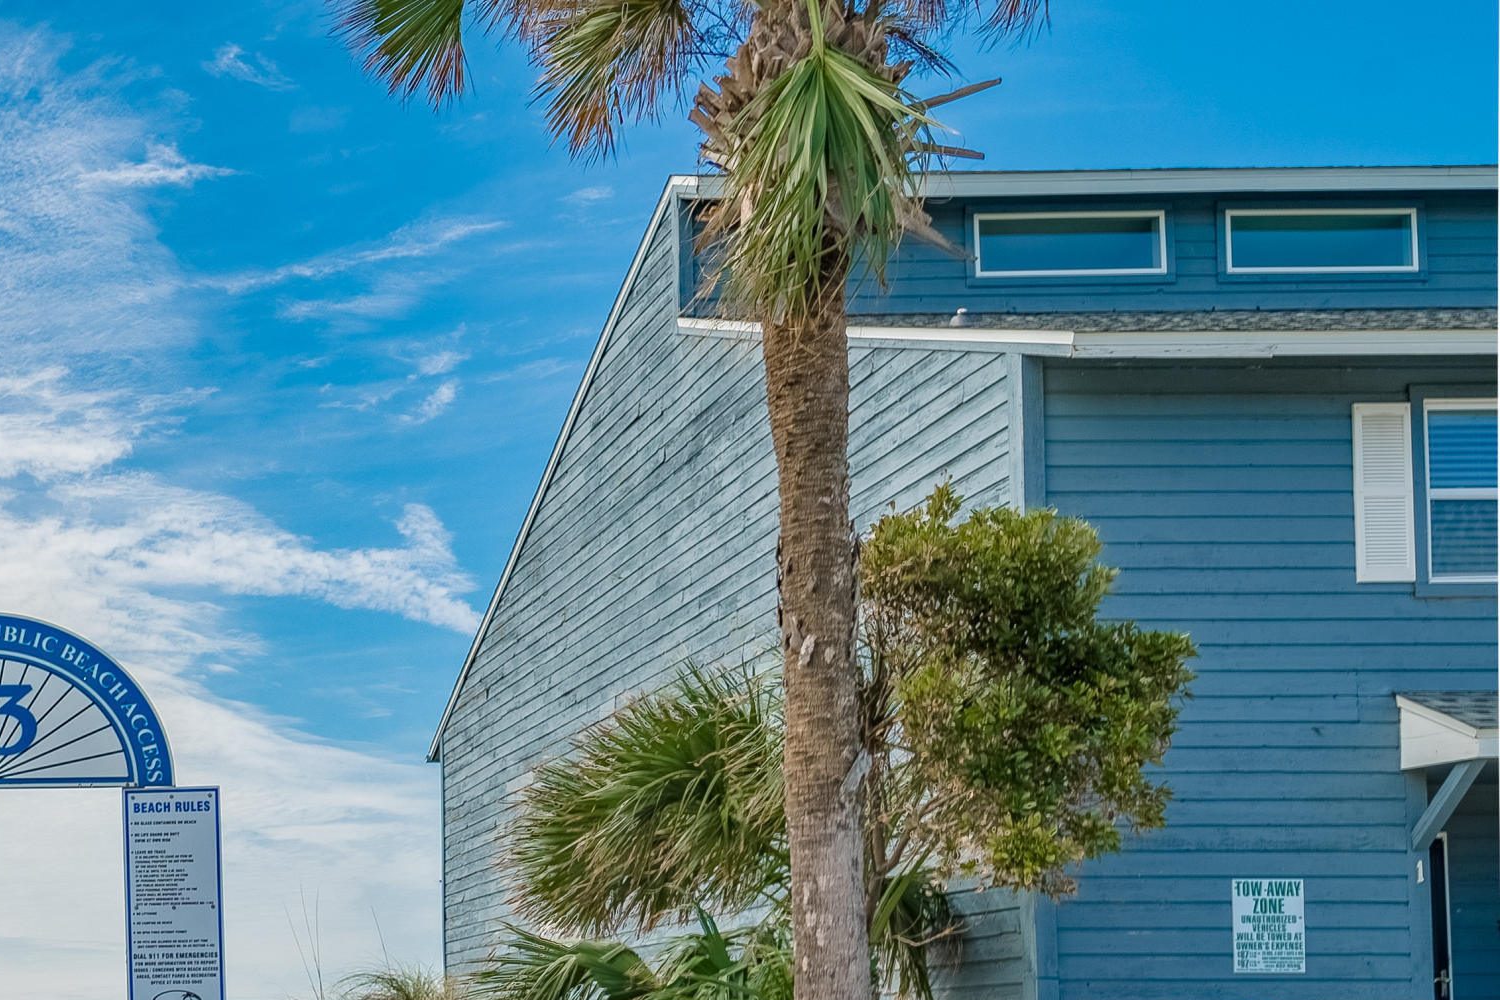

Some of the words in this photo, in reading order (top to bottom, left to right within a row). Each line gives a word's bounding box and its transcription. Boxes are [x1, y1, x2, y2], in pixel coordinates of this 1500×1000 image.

[62, 644, 128, 700] BEACH
[122, 702, 163, 783] ACCESS
[134, 802, 170, 813] BEACH
[175, 801, 210, 812] RULES
[1416, 859, 1424, 884] 1
[1253, 898, 1285, 914] ZONE
[1241, 915, 1297, 923] UNAUTHORIZED
[1236, 942, 1269, 950] OWNER'S
[1271, 942, 1303, 950] EXPENSE
